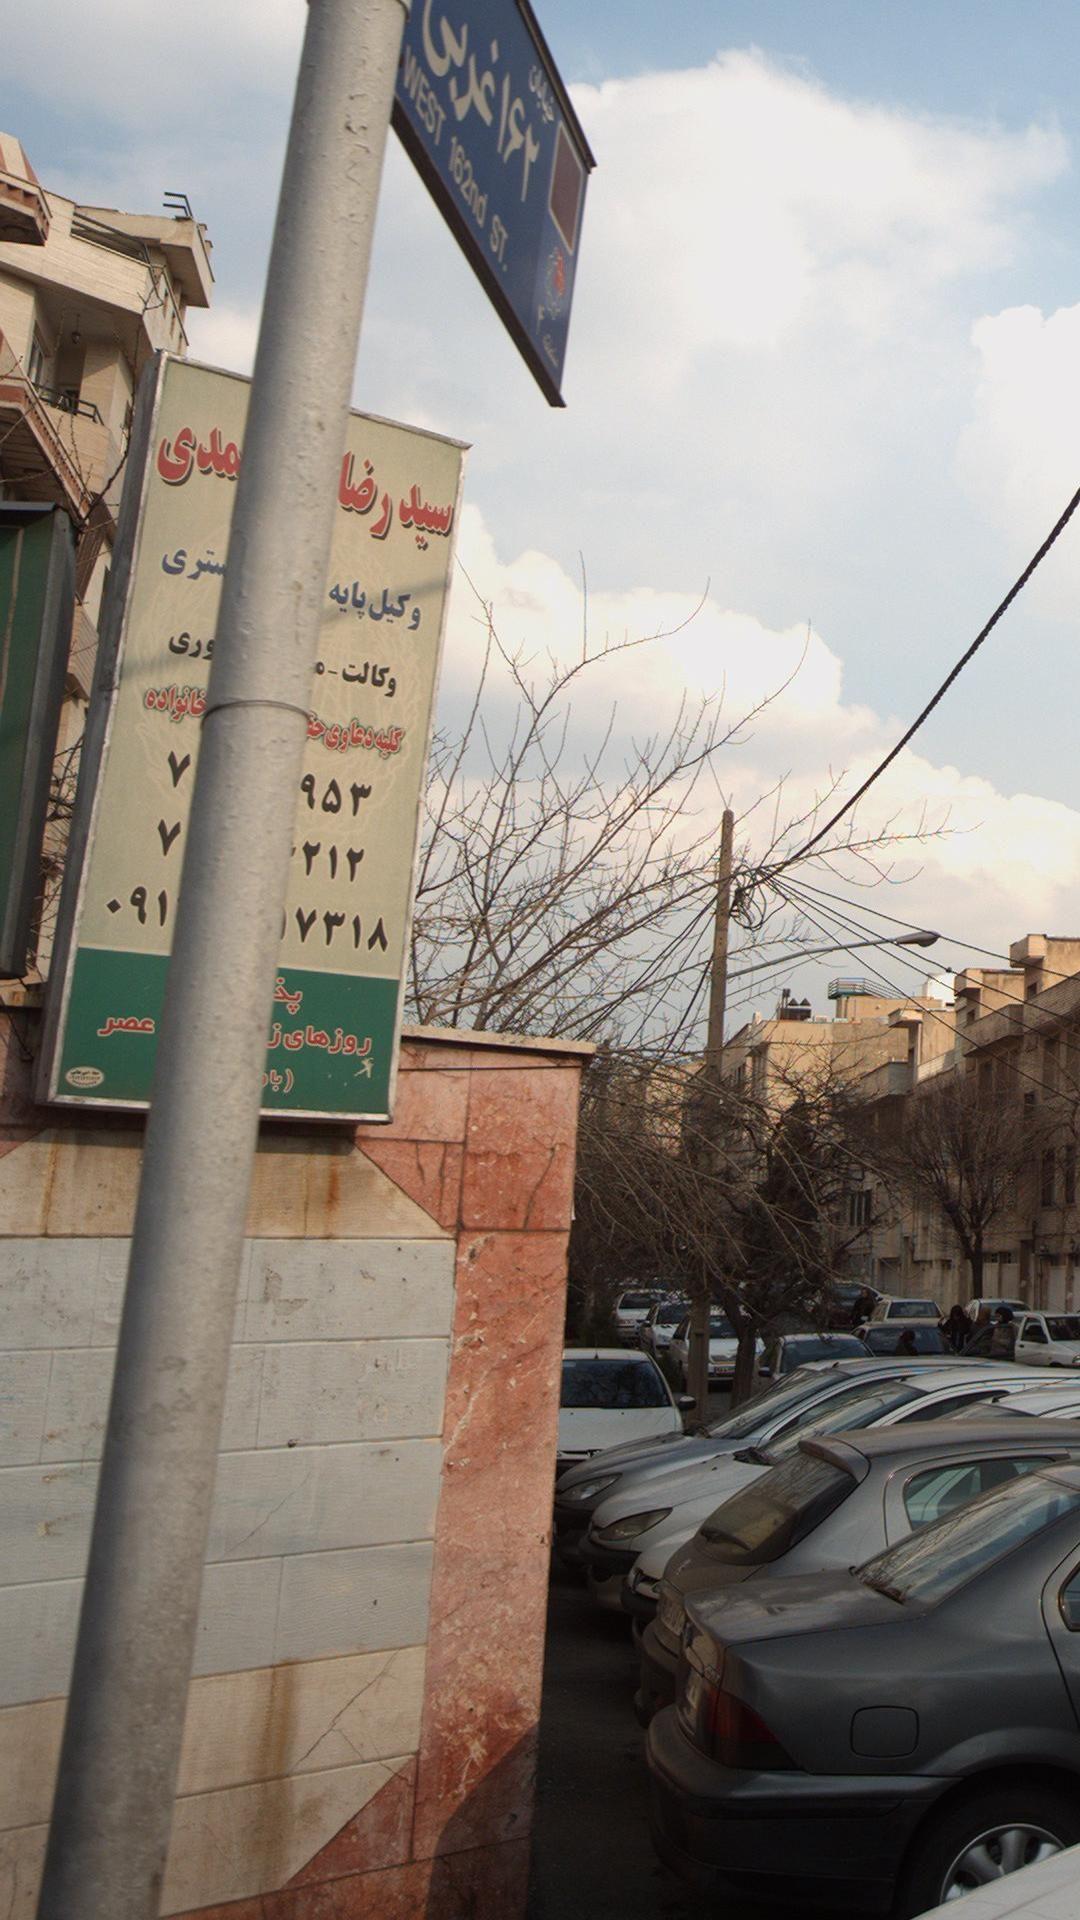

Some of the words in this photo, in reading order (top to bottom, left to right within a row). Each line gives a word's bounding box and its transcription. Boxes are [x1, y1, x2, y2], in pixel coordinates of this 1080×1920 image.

[422, 0, 499, 127] غربی
[403, 44, 446, 145] WEST
[449, 135, 488, 228] 162nd
[490, 214, 508, 272] ST.
[157, 426, 242, 487] مدی
[338, 450, 392, 541] رضا
[399, 483, 454, 551] سید
[161, 548, 226, 580] ستری
[328, 580, 366, 620] پایه
[368, 587, 421, 631] وکیل
[168, 631, 215, 661] وری
[97, 1016, 155, 1036] عصر
